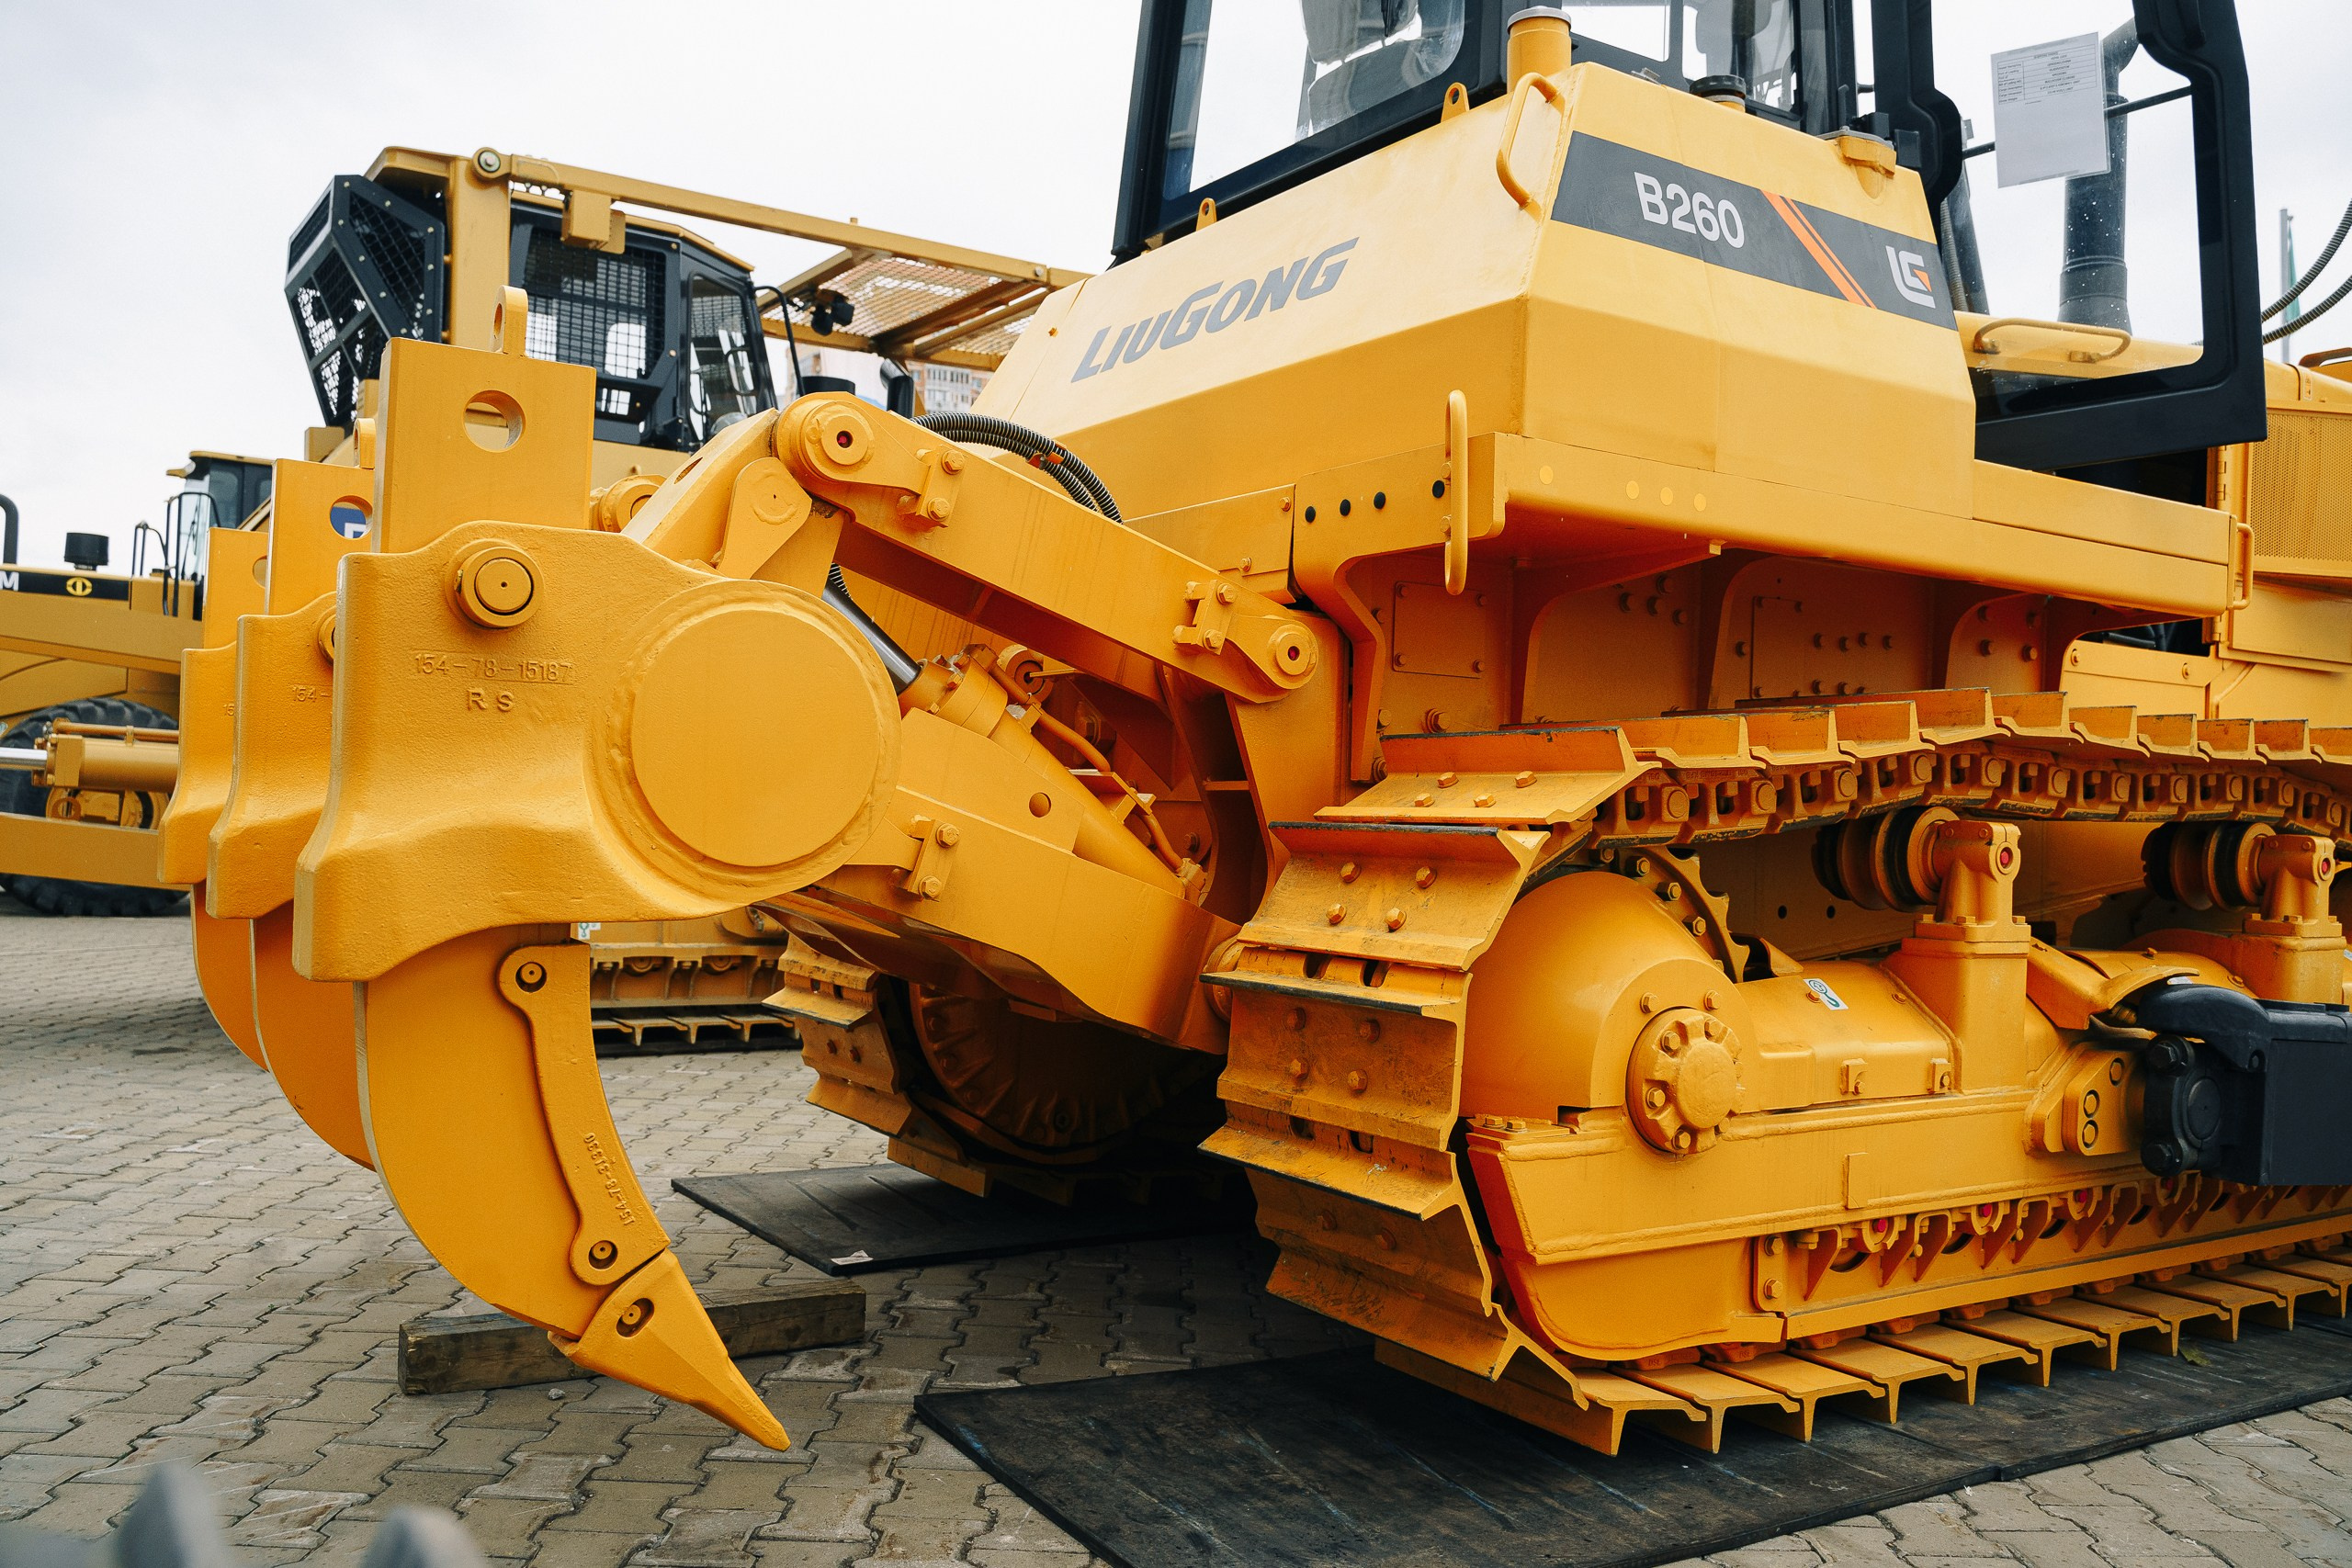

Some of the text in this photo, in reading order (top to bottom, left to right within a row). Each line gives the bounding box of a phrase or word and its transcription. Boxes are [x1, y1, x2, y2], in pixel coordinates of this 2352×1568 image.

[1634, 172, 1745, 249] B260
[1071, 236, 1360, 384] LIUGONG
[414, 653, 573, 682] 154-78-15187
